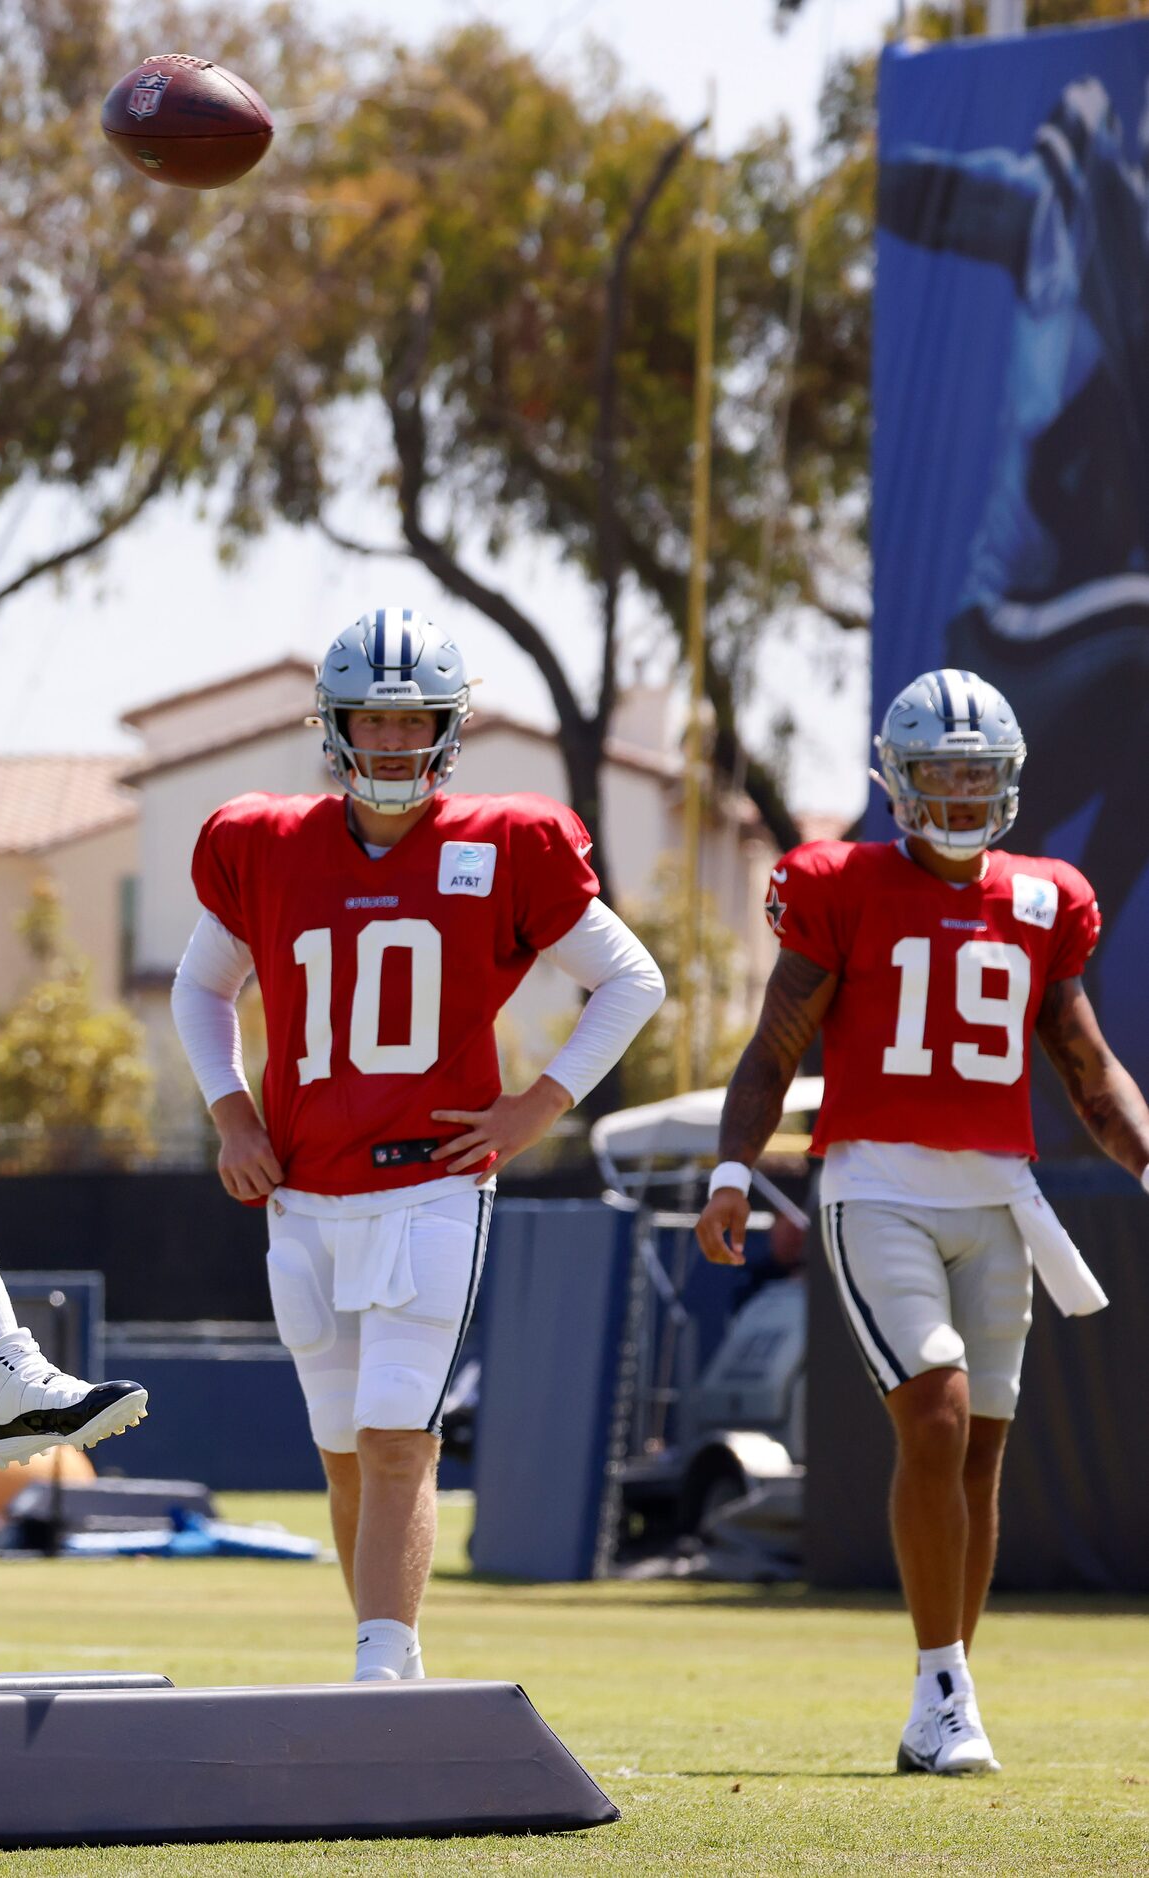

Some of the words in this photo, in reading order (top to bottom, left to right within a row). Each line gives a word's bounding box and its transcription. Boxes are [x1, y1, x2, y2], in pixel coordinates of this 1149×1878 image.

[451, 875, 482, 888] AT&T
[293, 918, 442, 1086] 10
[882, 937, 1031, 1086] 19
